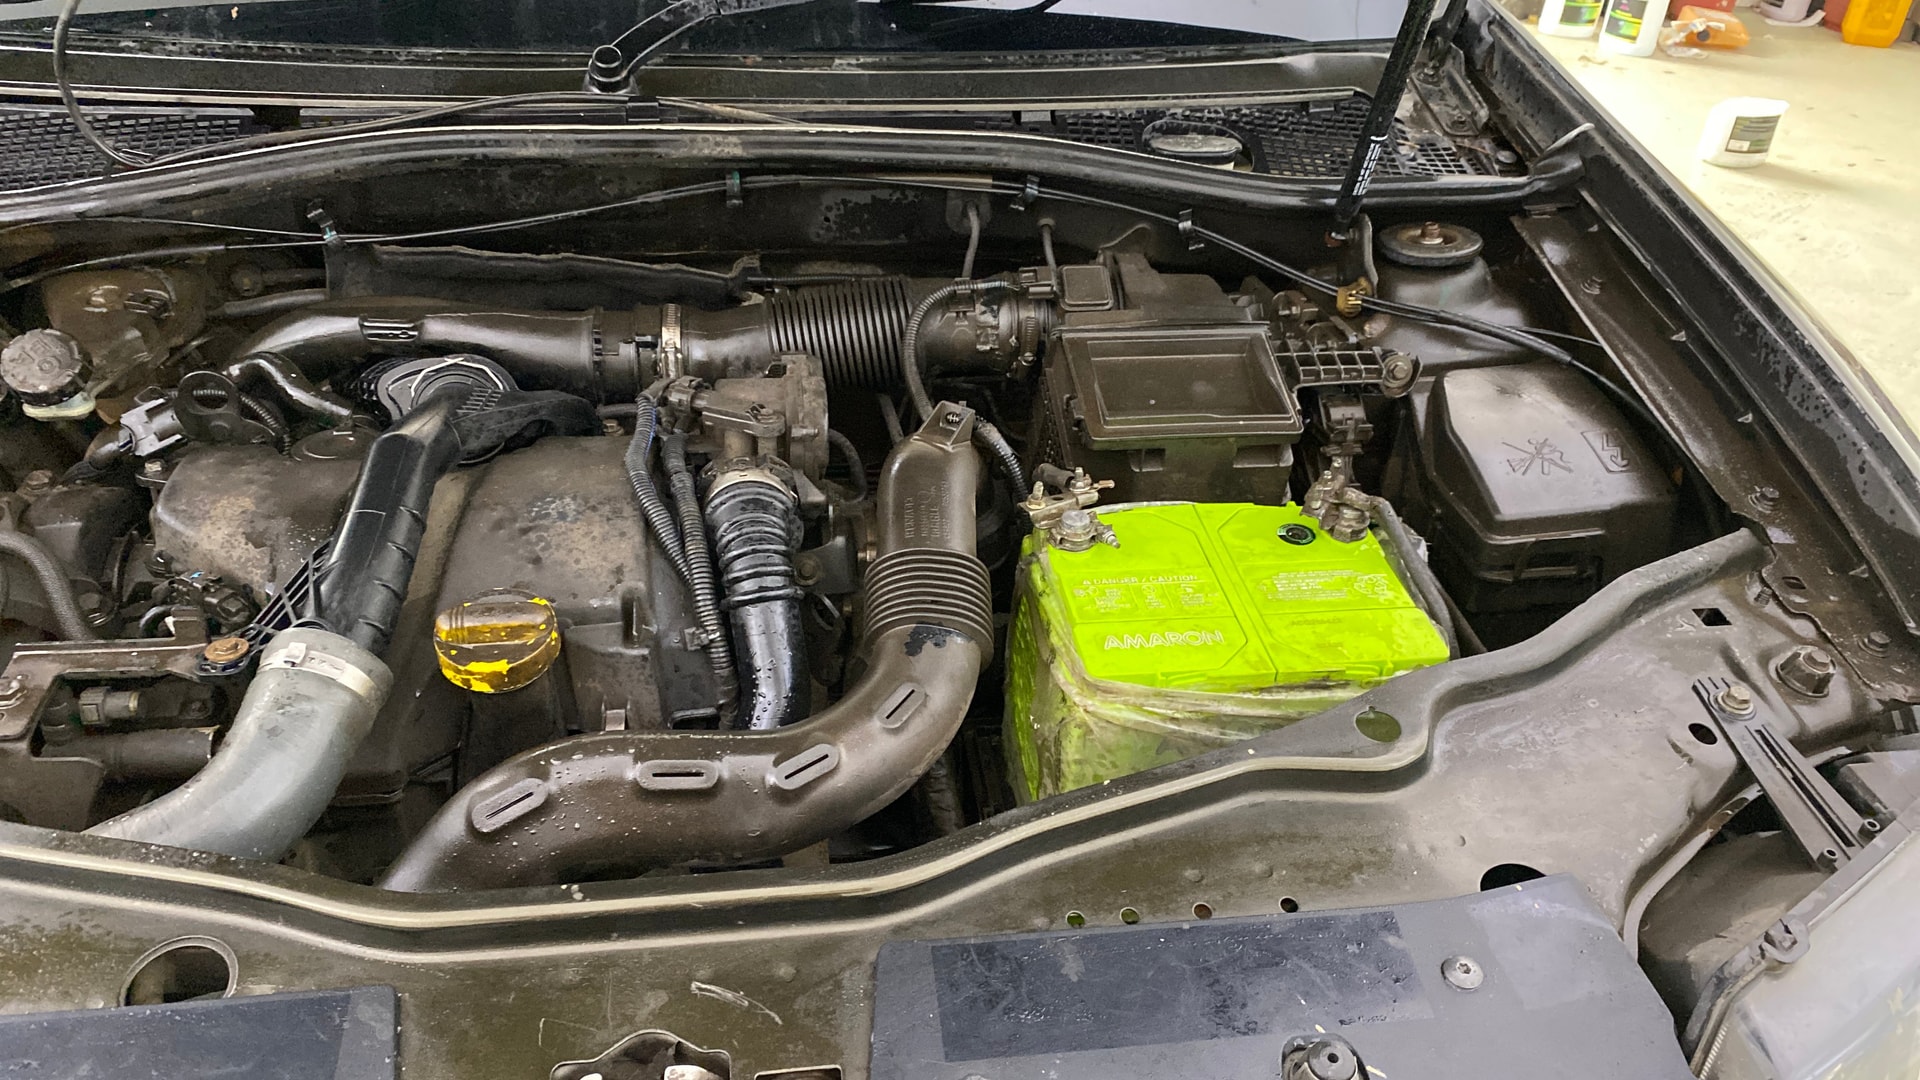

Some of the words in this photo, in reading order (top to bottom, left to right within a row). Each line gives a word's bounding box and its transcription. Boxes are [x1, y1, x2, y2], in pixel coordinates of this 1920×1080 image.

[1094, 577, 1138, 585] DANGER
[1149, 575, 1198, 583] CAUTION
[1104, 630, 1225, 650] AMARON
